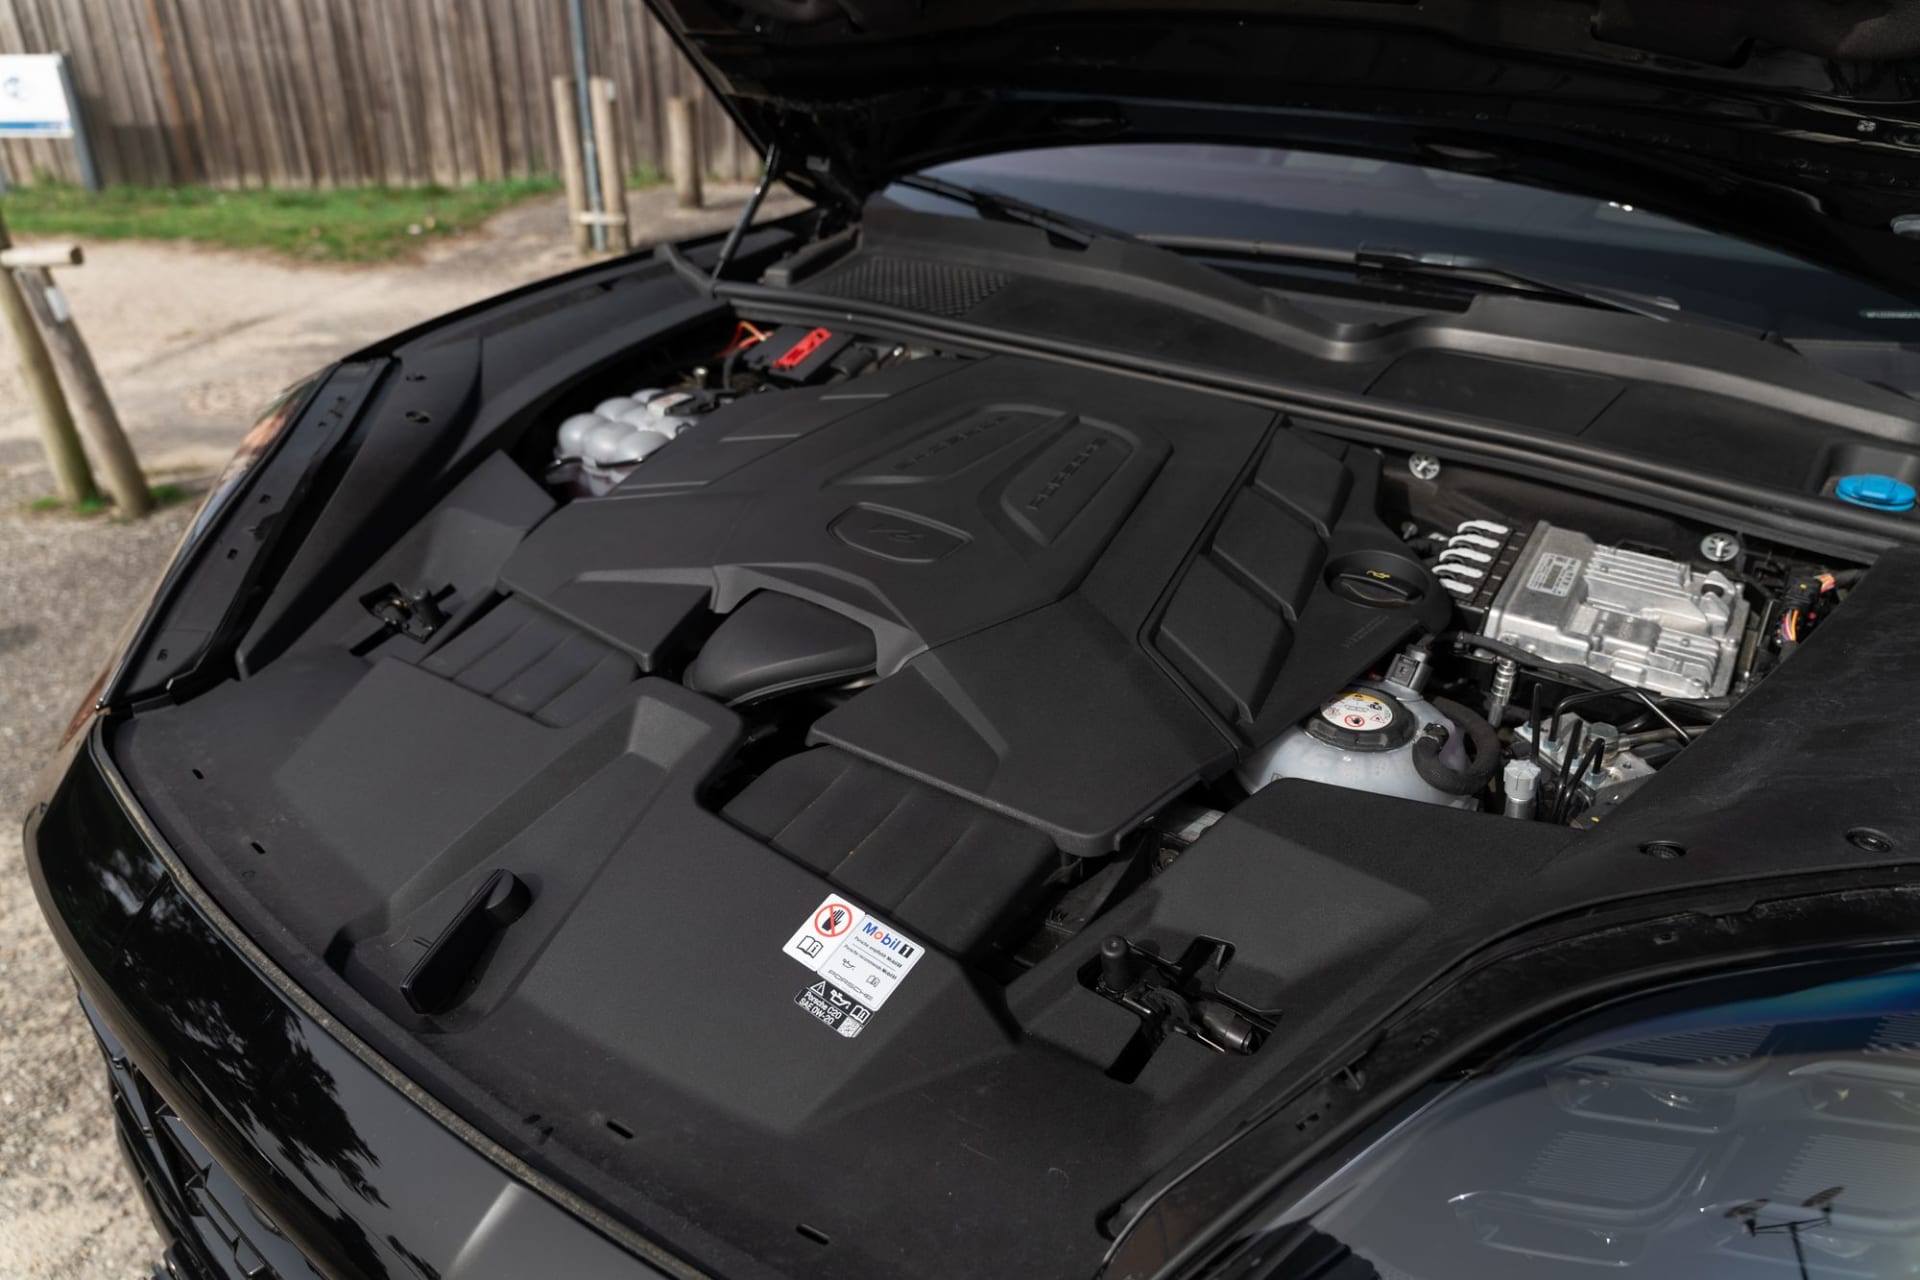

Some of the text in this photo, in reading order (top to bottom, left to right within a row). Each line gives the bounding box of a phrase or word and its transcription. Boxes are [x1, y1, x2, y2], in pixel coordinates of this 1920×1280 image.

[862, 922, 902, 951] Mobil
[828, 969, 874, 1001] PORSCHE
[798, 997, 813, 1010] SAE
[803, 991, 842, 1020] Porsche C20
